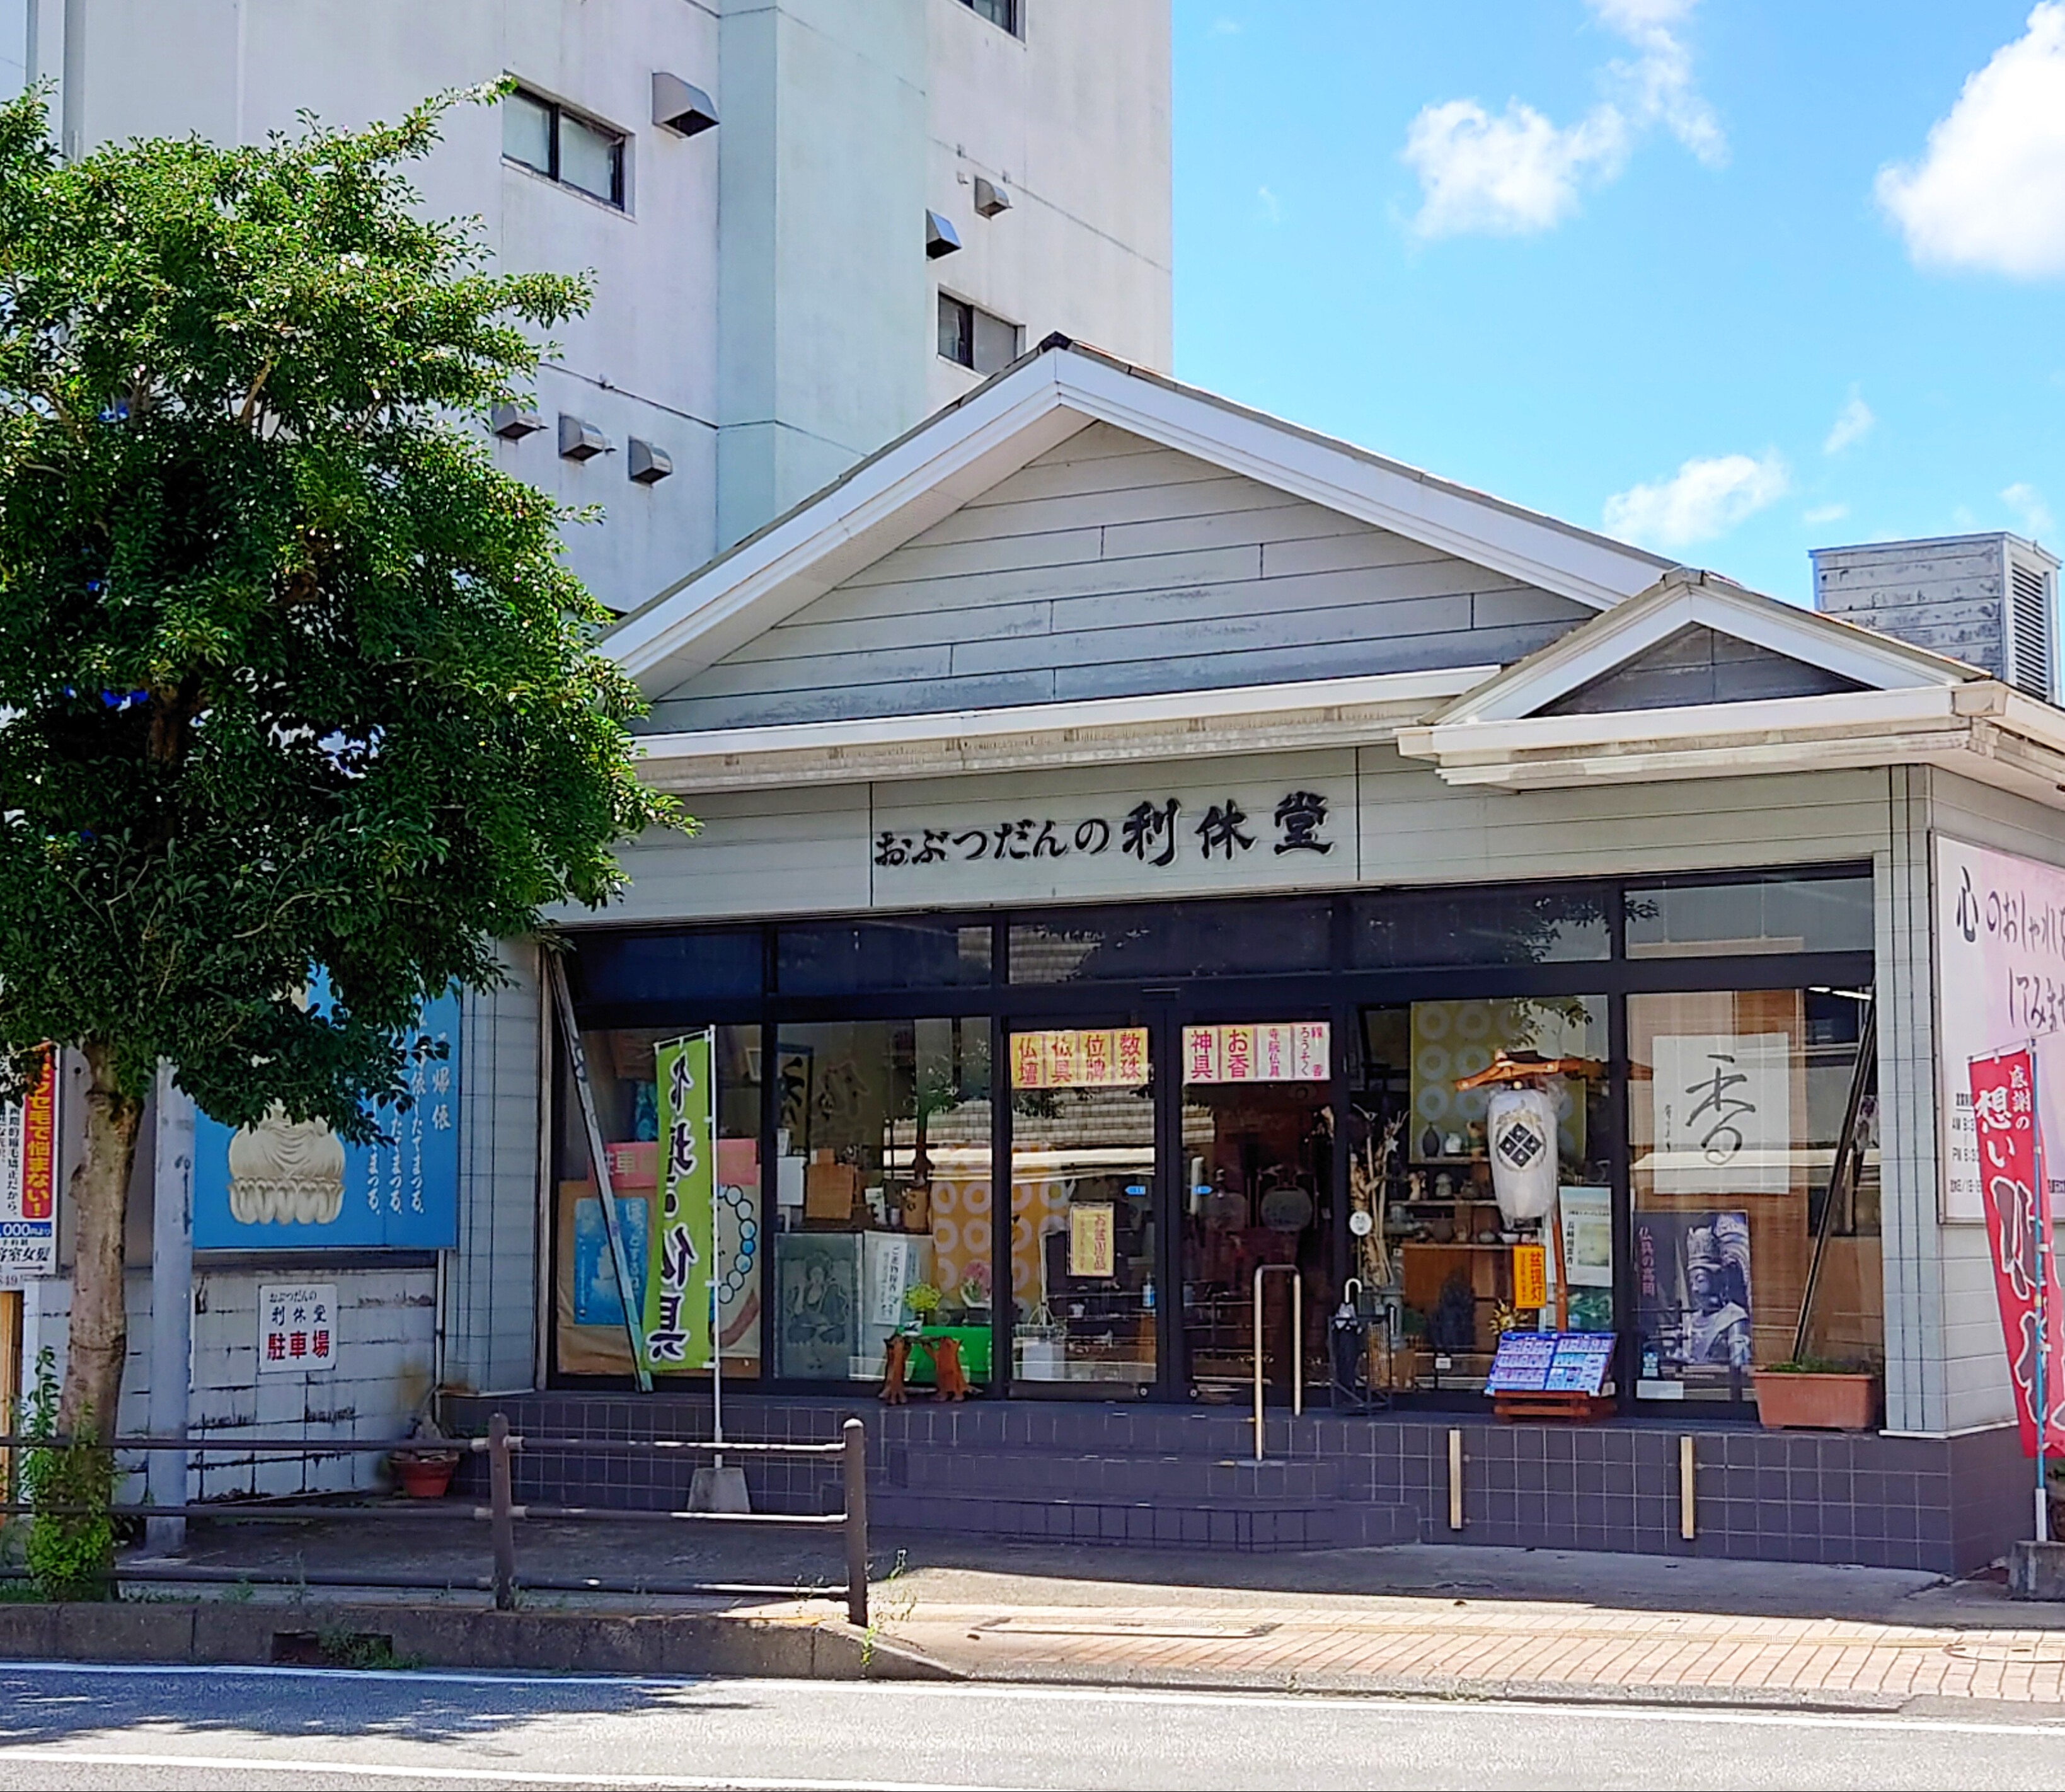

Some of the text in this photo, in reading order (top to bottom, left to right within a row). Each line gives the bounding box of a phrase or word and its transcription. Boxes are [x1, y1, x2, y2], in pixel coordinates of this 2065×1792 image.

[875, 791, 1333, 866] おぶつだんの利休堂
[1018, 1037, 1038, 1084] 仏壇
[1051, 1035, 1073, 1083] 仏具
[1085, 1034, 1105, 1083] 位牌
[1120, 1032, 1141, 1080] 数珠
[1190, 1030, 1212, 1079] 神具
[1228, 1029, 1249, 1078] お香
[1975, 1086, 2015, 1168] 想い
[272, 1304, 327, 1326] 利休堂
[267, 1329, 330, 1361] 駐車場
